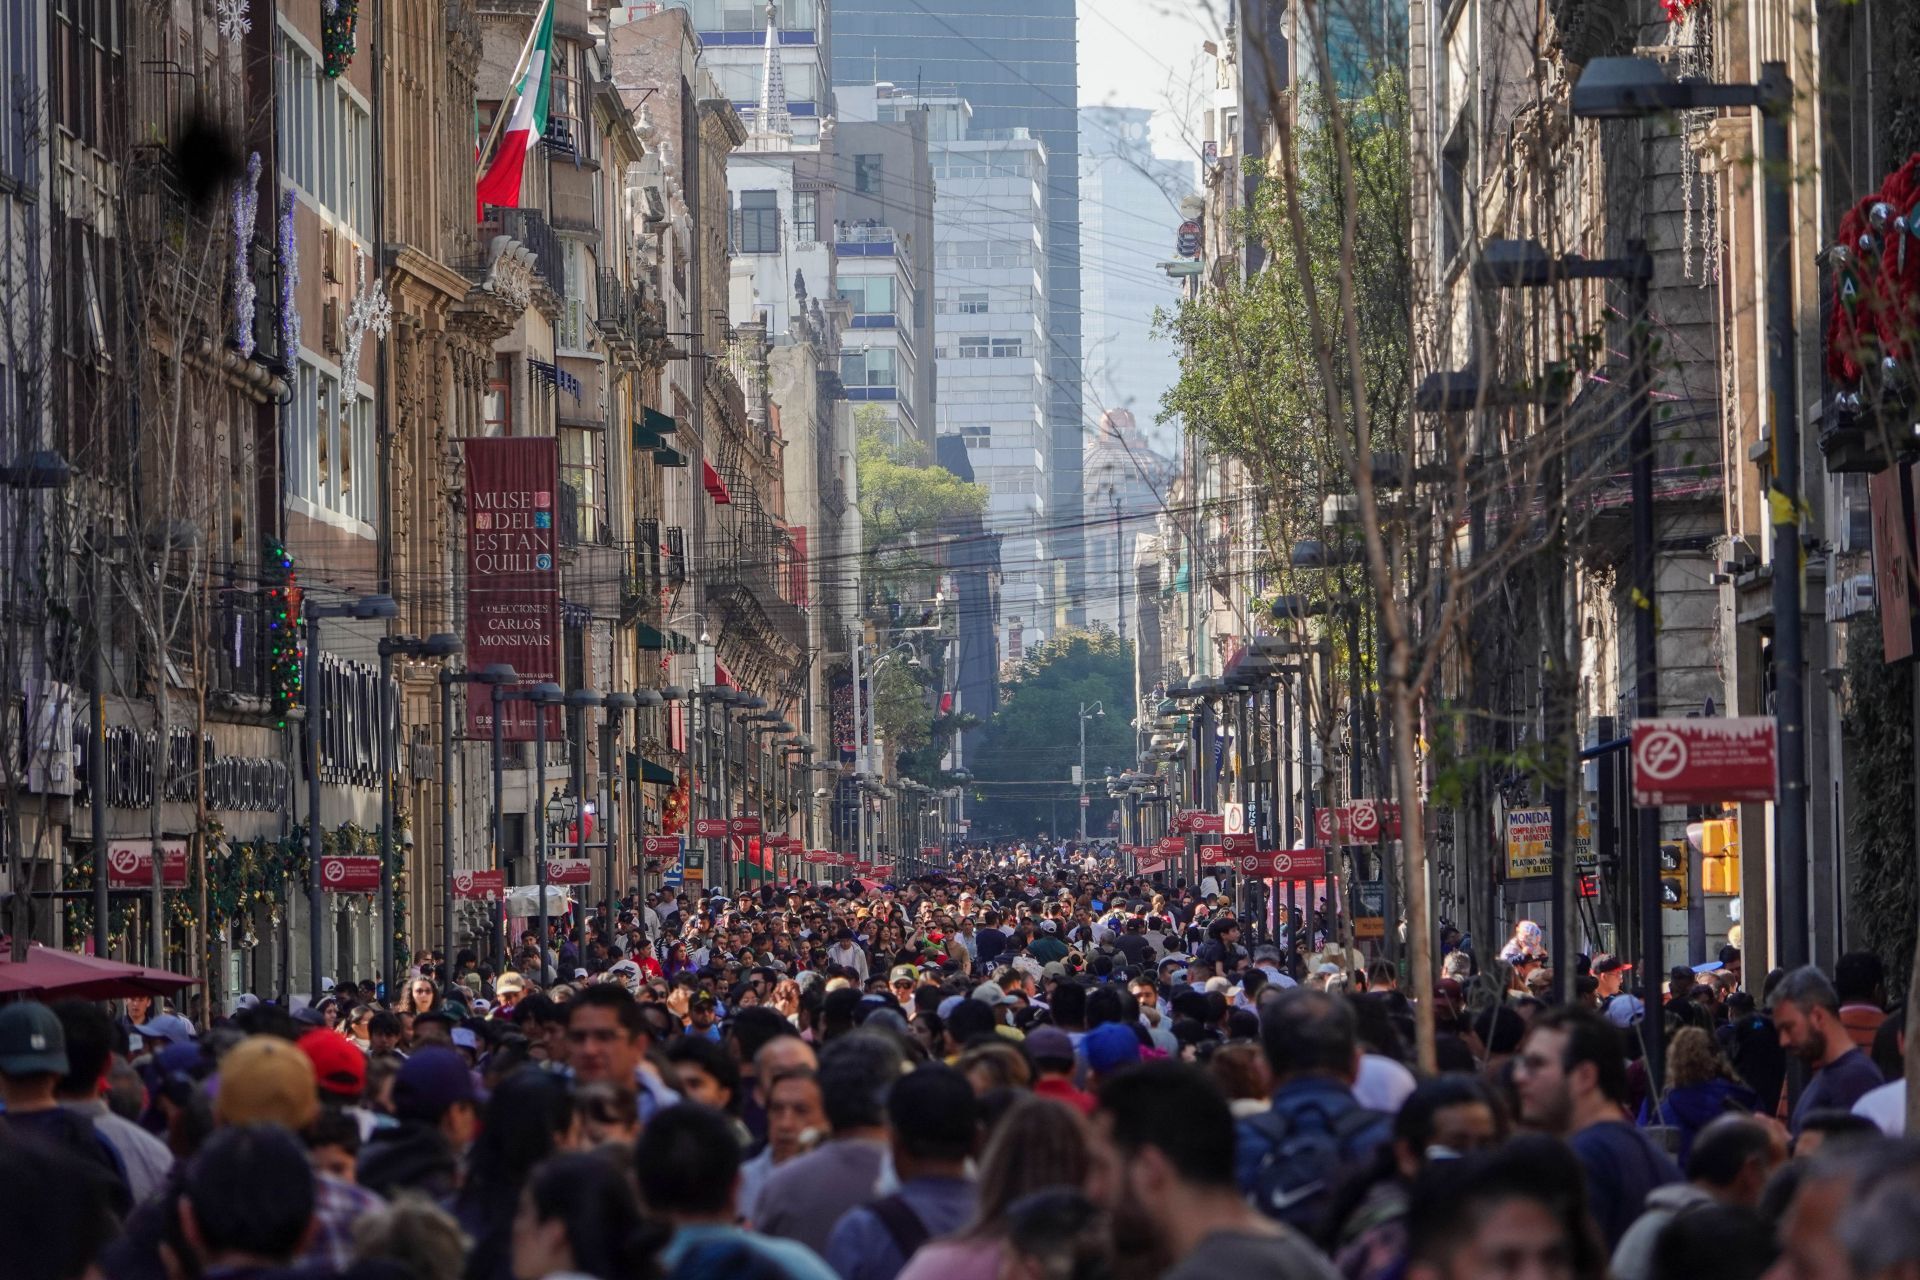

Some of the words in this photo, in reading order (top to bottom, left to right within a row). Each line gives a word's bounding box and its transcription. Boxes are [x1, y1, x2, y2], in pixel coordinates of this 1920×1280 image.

[495, 512, 534, 530] DEL
[475, 533, 549, 551] ESTAN
[480, 604, 549, 614] COLECCIONES
[488, 618, 541, 630] CARLOS
[1510, 812, 1552, 825] MONEDA
[1533, 865, 1552, 874] BILLET
